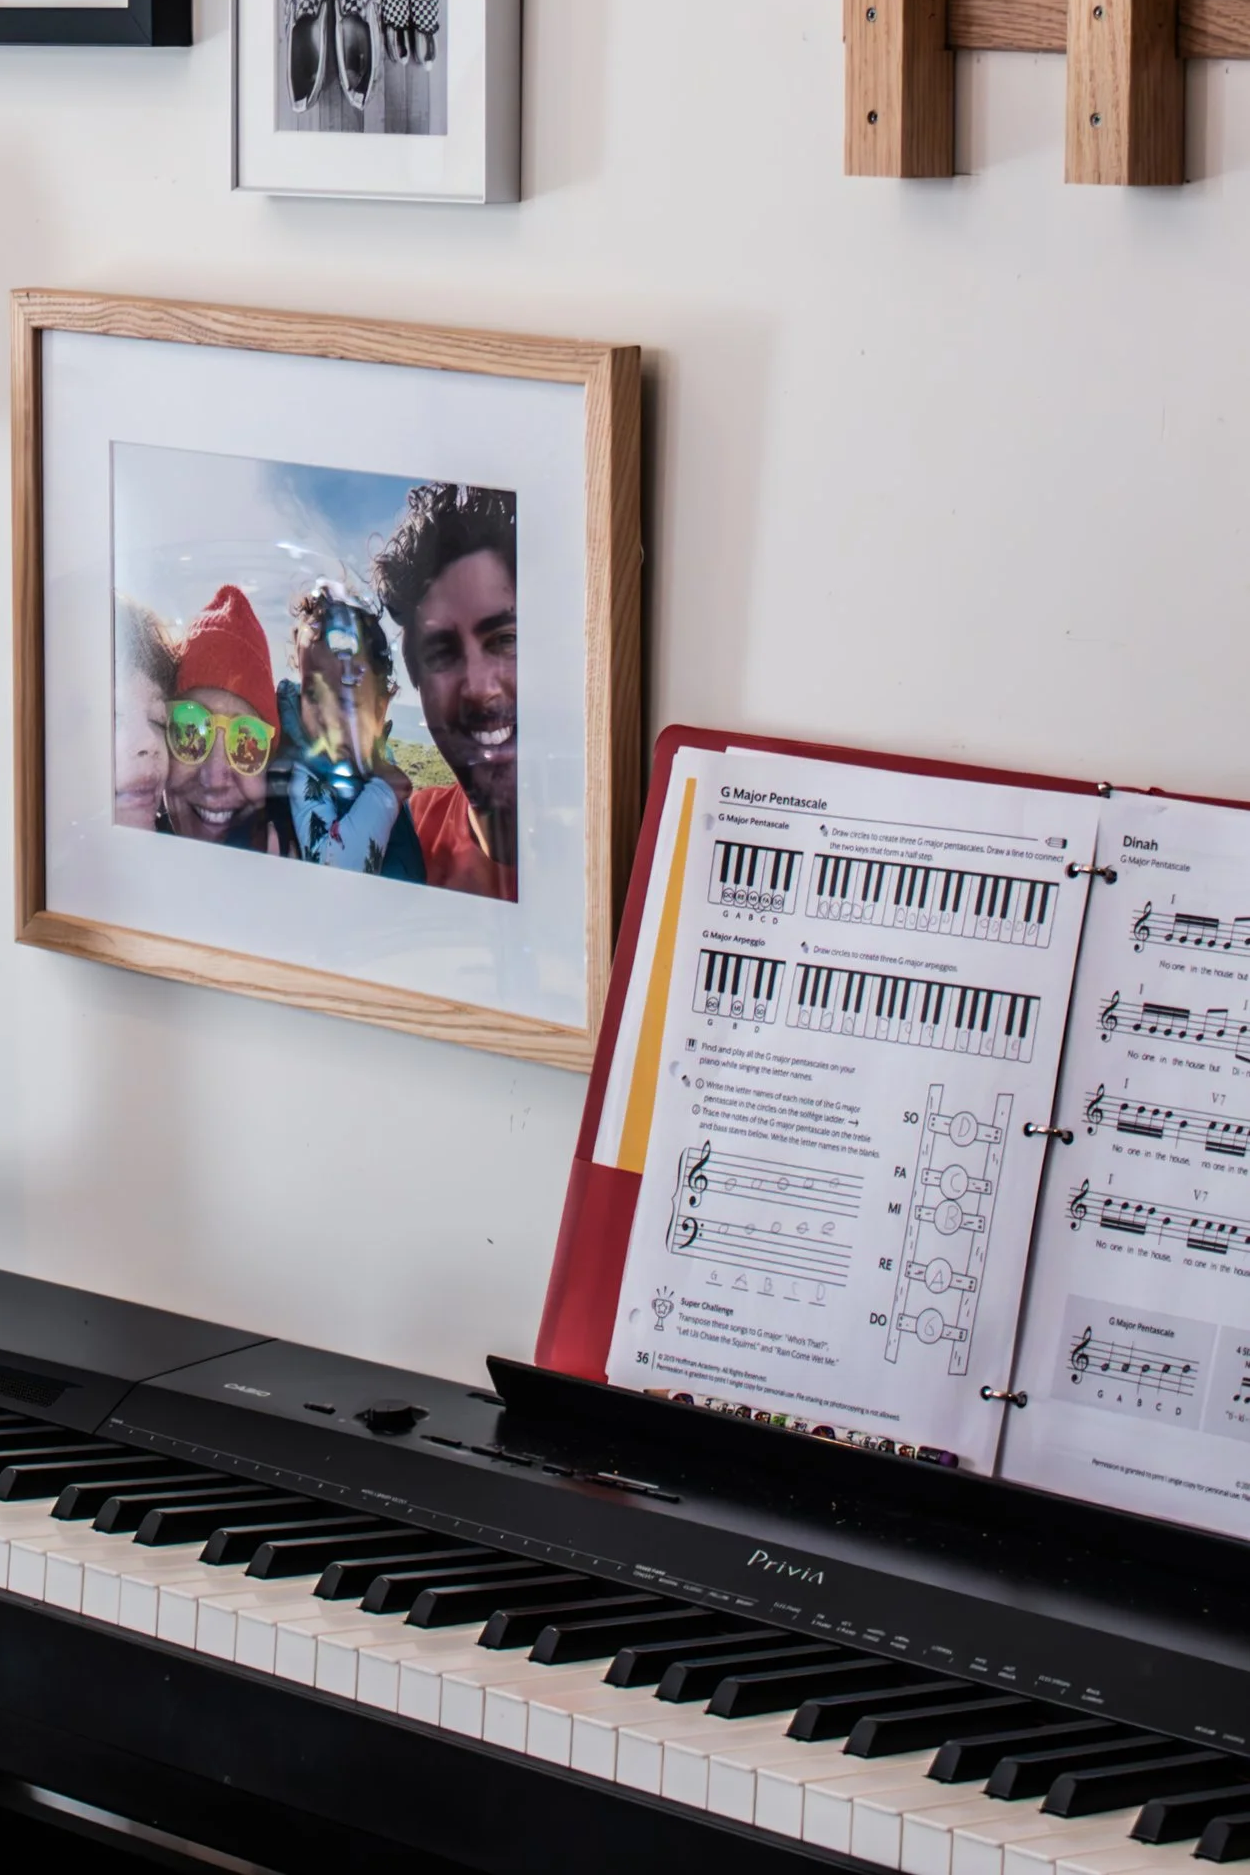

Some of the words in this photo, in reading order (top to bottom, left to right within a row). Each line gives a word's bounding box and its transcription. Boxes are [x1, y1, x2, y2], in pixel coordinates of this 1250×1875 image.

[720, 786, 730, 798] G
[733, 787, 767, 804] Major
[768, 791, 827, 810] Pentascale
[717, 812, 724, 822] G
[725, 814, 748, 826] Major
[749, 817, 789, 830] Pentascale
[1123, 835, 1159, 851] Dinah
[1119, 854, 1126, 864] G
[1127, 856, 1150, 867] Major
[1150, 858, 1190, 873] Pentascale
[723, 910, 729, 918] G
[772, 917, 778, 925] D
[702, 929, 709, 939] G
[709, 931, 732, 942] Major
[732, 934, 765, 948] Arpeggio
[1158, 960, 1170, 970] No
[1171, 963, 1185, 971] one
[1189, 965, 1197, 974] in
[1200, 966, 1212, 976] the
[1213, 968, 1233, 979] house
[1236, 972, 1248, 982] but
[701, 1042, 717, 1053] Find
[717, 1046, 731, 1055] and
[731, 1048, 745, 1058] play
[745, 1049, 754, 1059] all
[754, 1051, 764, 1060] the
[765, 1052, 771, 1062] G
[771, 1054, 790, 1065] major
[790, 1057, 829, 1071] pentascales
[829, 1063, 839, 1071] on
[839, 1065, 855, 1075] your
[1127, 1049, 1139, 1060] No
[1141, 1053, 1155, 1062] one
[1159, 1056, 1167, 1064] in
[1172, 1057, 1183, 1067] the
[1185, 1060, 1205, 1070] house
[1208, 1063, 1220, 1073] but
[706, 1080, 723, 1091] Write
[723, 1084, 734, 1093] the
[734, 1086, 751, 1095] letter
[752, 1089, 773, 1100] names
[774, 1092, 782, 1101] of
[782, 1094, 797, 1103] each
[798, 1097, 814, 1107] note
[814, 1099, 822, 1107] of
[823, 1100, 834, 1109] the
[834, 1101, 840, 1111] G
[841, 1104, 860, 1115] major
[903, 1111, 919, 1125] SO
[1112, 1143, 1123, 1154] No
[1127, 1148, 1140, 1157] one
[1144, 1150, 1151, 1158] in
[1155, 1152, 1166, 1161] the
[1169, 1154, 1190, 1166] house,
[1201, 1160, 1211, 1169] no
[1212, 1163, 1225, 1172] one
[1227, 1165, 1234, 1173] in
[1237, 1166, 1248, 1176] the
[894, 1166, 907, 1179] FA
[888, 1203, 902, 1215] MI
[878, 1257, 893, 1271] RE
[1095, 1239, 1106, 1249] No
[1109, 1243, 1122, 1252] one
[1126, 1246, 1134, 1254] in
[1137, 1247, 1148, 1258] the
[1150, 1250, 1171, 1263] house,
[1182, 1257, 1192, 1266] no
[1194, 1260, 1206, 1269] one
[1209, 1262, 1217, 1271] in
[1219, 1264, 1230, 1274] the
[680, 1297, 700, 1309] Super
[701, 1301, 733, 1317] Challenge
[678, 1312, 711, 1327] Transpose
[711, 1319, 729, 1331] these
[729, 1324, 748, 1336] songs
[748, 1327, 756, 1336] to
[755, 1328, 762, 1338] G
[869, 1313, 887, 1326] DO
[1108, 1316, 1115, 1326] G
[1115, 1318, 1136, 1331] Major
[1137, 1322, 1174, 1338] Pentascale
[676, 1326, 689, 1337] "Let
[689, 1329, 699, 1339] Us
[699, 1330, 719, 1343] Chase
[719, 1335, 731, 1345] the
[759, 1344, 773, 1354] and
[774, 1346, 790, 1357] "Rain
[790, 1349, 810, 1362] Come
[811, 1354, 824, 1364] Wet
[635, 1351, 650, 1365] 36
[223, 1383, 271, 1397] CASIO
[1097, 1390, 1104, 1399] G
[1116, 1394, 1123, 1403] A
[1137, 1398, 1142, 1407] B
[1155, 1402, 1162, 1412] C
[1175, 1407, 1182, 1416] D
